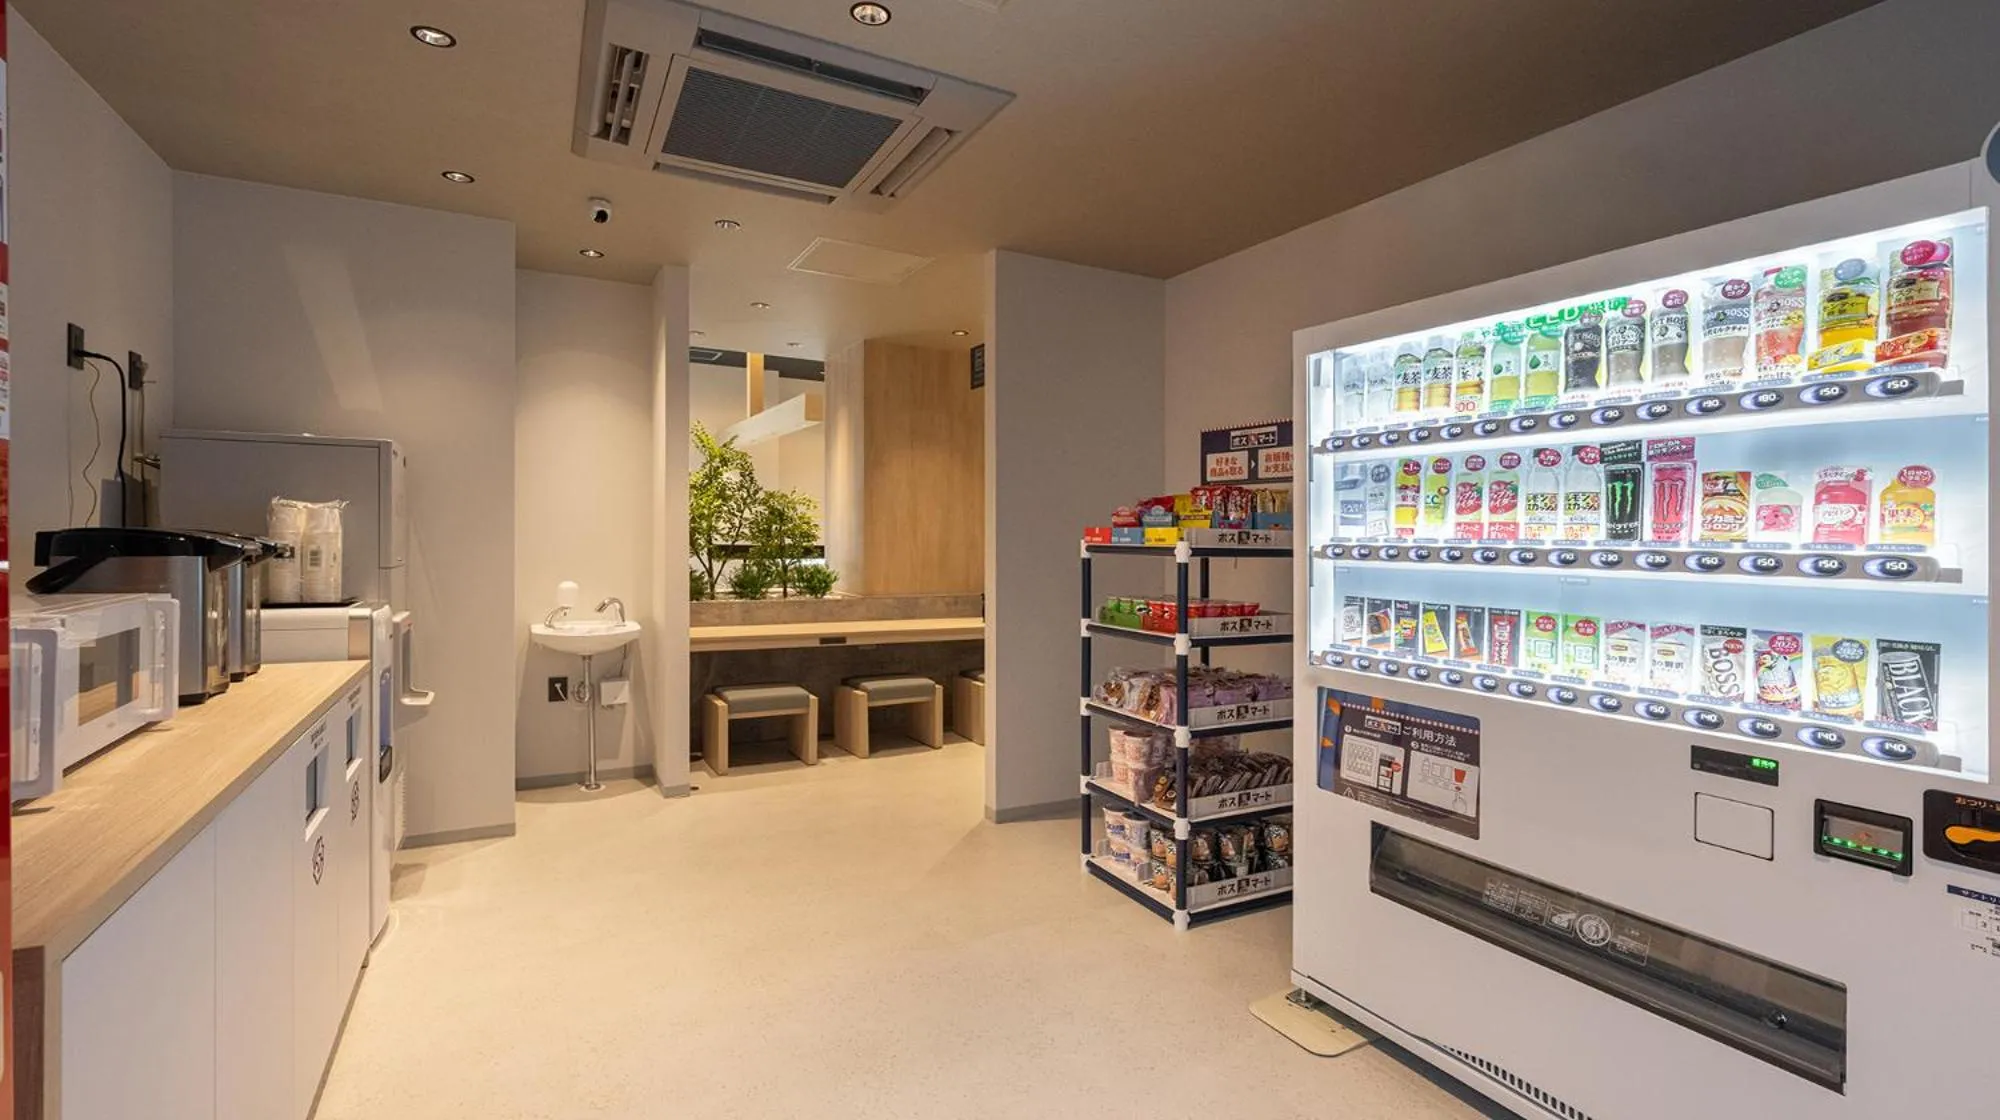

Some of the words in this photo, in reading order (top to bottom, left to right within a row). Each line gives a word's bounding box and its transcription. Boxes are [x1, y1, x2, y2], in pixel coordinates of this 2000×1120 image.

[1887, 379, 1909, 390] 150
[1819, 386, 1840, 397] 150
[1216, 456, 1238, 466] 好きな
[1264, 451, 1293, 463] 自販機
[1647, 554, 1666, 563] 230
[1701, 556, 1718, 565] 150
[1757, 557, 1776, 567] 150
[1818, 559, 1838, 569] 150
[1885, 561, 1908, 571] 150
[1709, 647, 1741, 696] BOSS
[1888, 662, 1933, 723] BLACK
[1650, 705, 1665, 714] 150
[1700, 713, 1717, 722] 140
[1756, 722, 1774, 732] 140
[1402, 726, 1457, 747] ご利用方法
[1817, 731, 1837, 742] 140
[1885, 742, 1906, 753] 140
